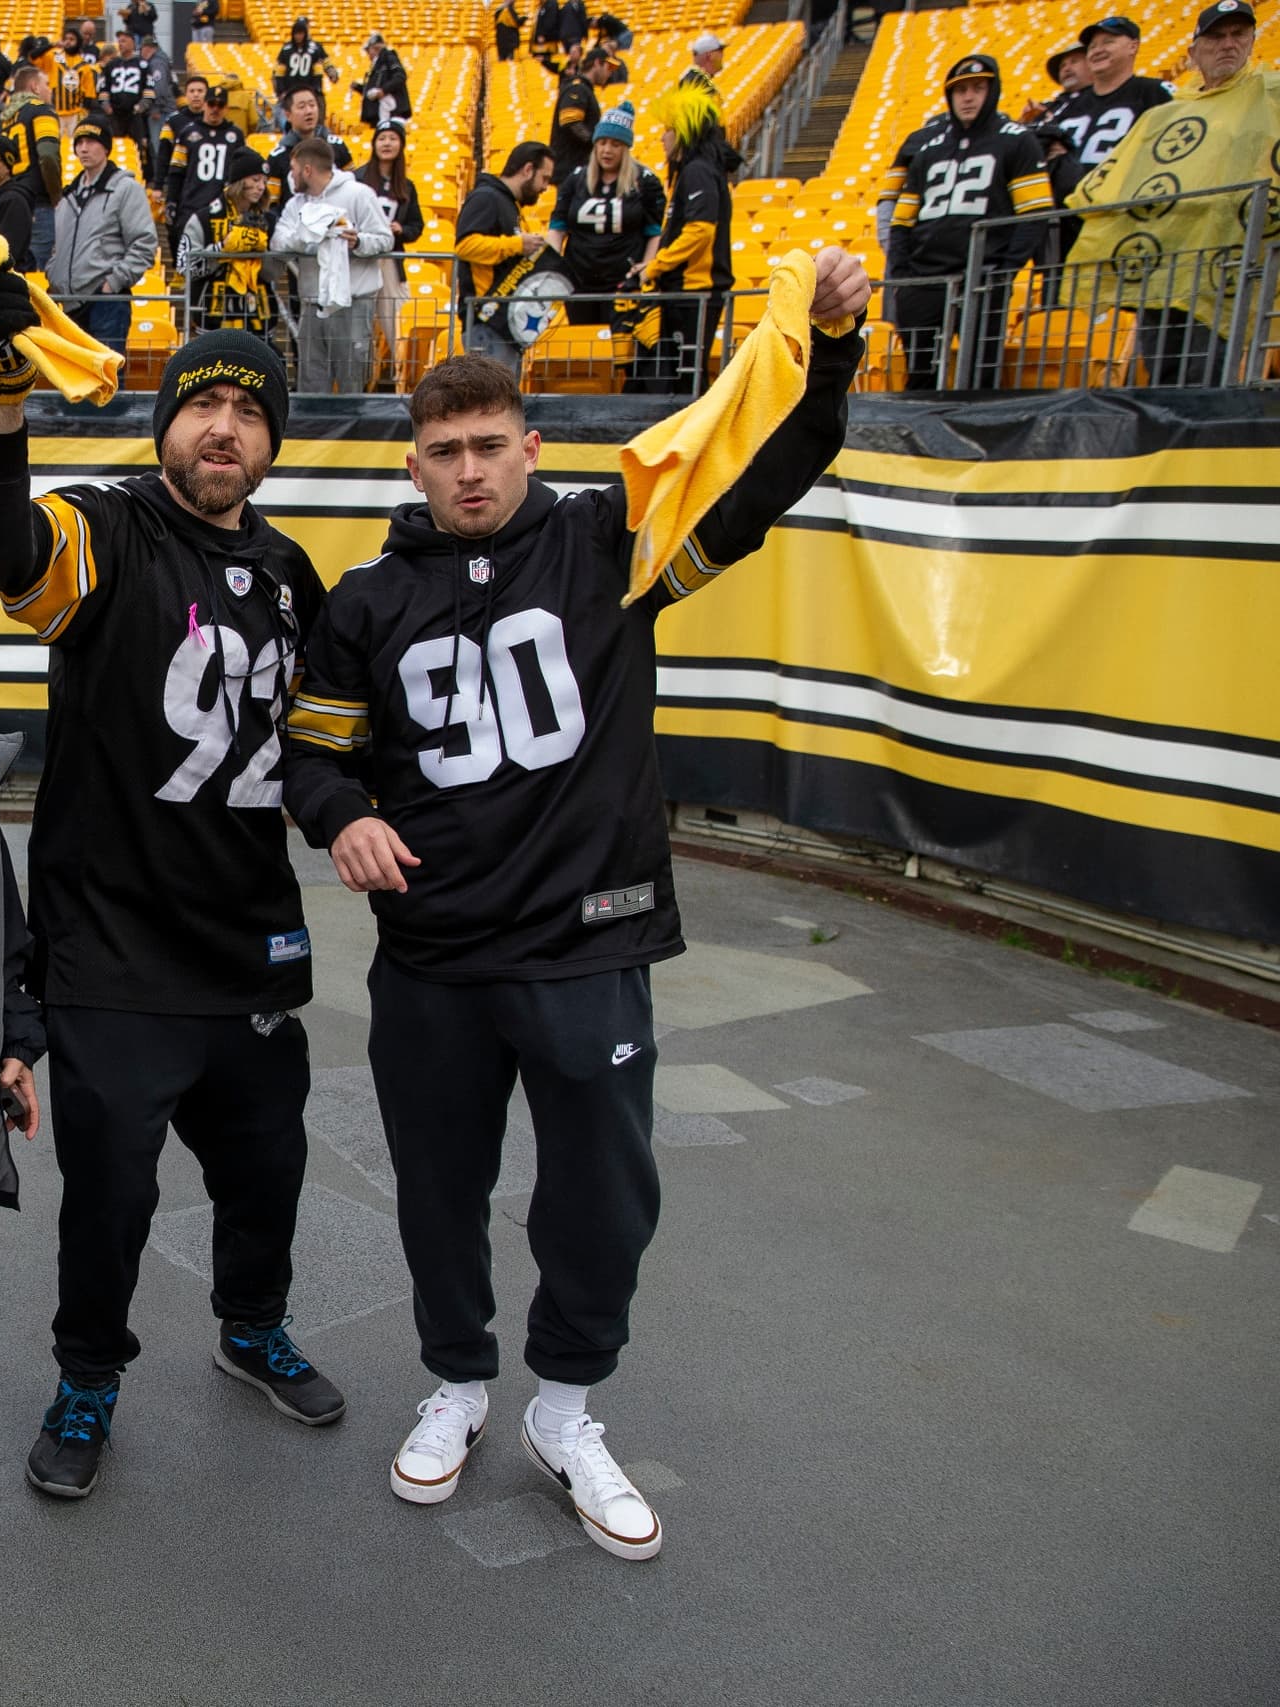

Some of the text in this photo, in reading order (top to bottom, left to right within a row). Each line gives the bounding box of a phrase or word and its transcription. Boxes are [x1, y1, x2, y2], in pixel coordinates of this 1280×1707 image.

[111, 67, 140, 94] 32
[289, 53, 312, 77] 90
[197, 143, 227, 182] 81
[918, 154, 996, 221] 22
[577, 197, 622, 234] 41
[175, 359, 267, 399] Pittsburgh
[154, 624, 296, 808] 92
[398, 607, 586, 788] 90
